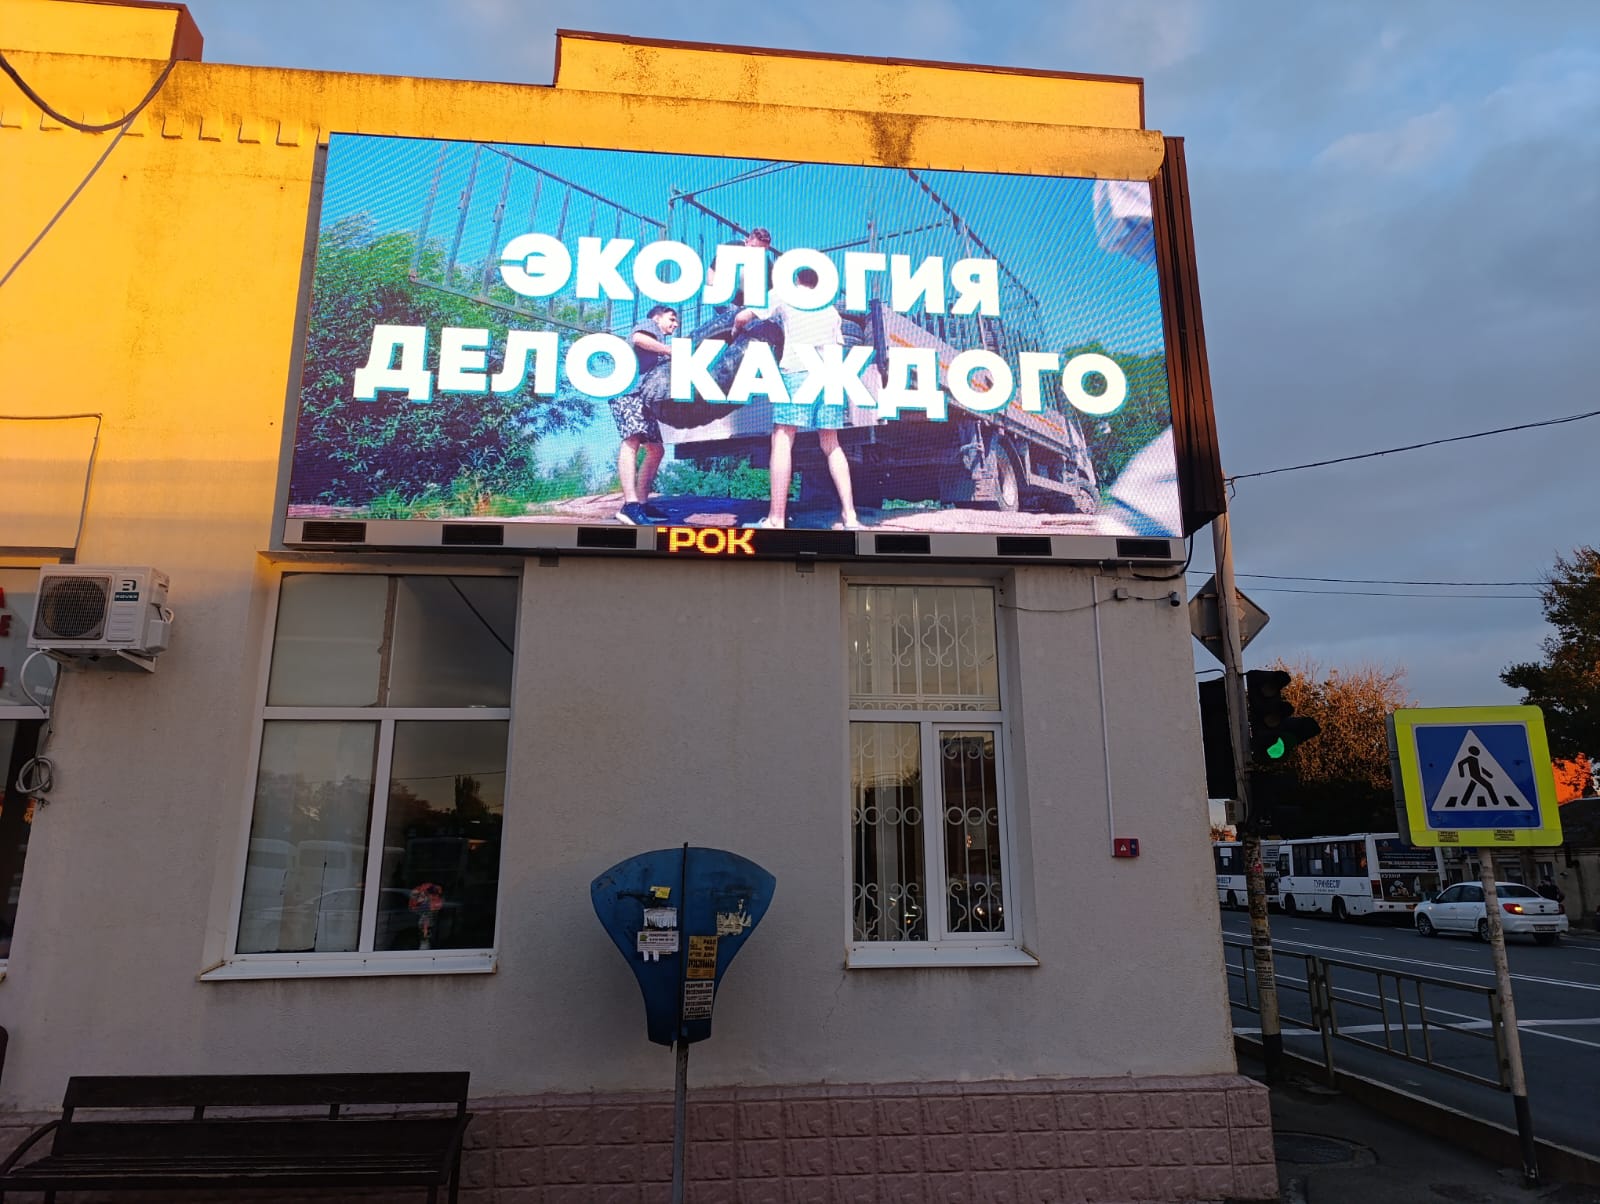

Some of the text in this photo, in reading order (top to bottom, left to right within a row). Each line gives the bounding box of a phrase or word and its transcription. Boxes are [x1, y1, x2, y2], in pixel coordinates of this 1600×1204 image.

[500, 233, 1001, 317] ЭКОЛОГИЯ
[353, 324, 1128, 420] ДЕЛО КАЖДОГО
[657, 527, 755, 554] РОК
